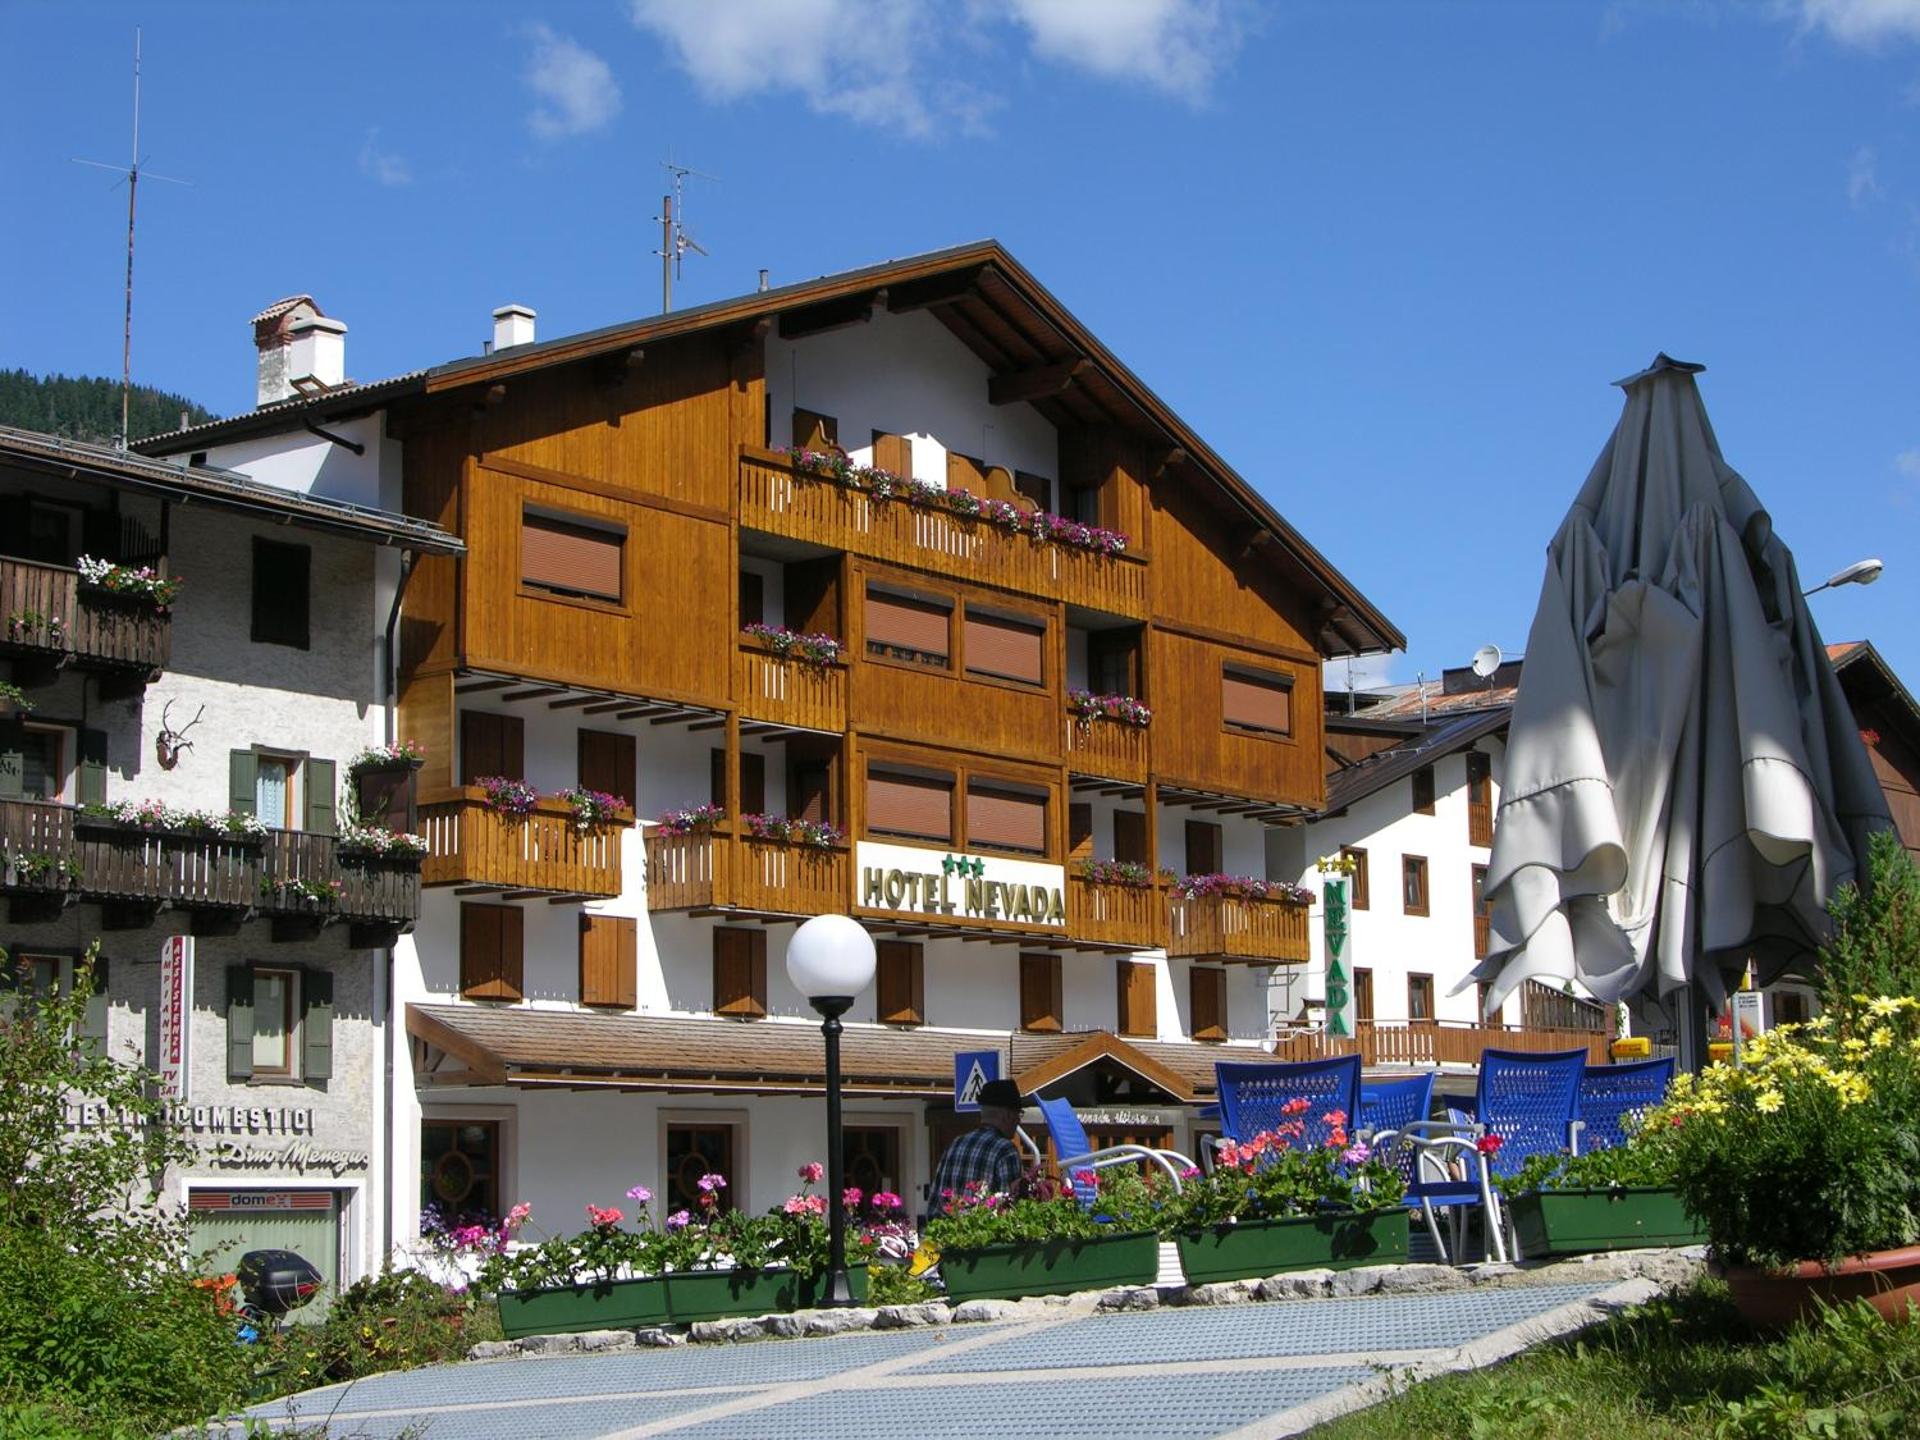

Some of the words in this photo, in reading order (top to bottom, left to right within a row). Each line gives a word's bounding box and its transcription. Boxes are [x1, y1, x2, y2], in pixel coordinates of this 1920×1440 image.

[864, 867, 956, 911] HOTEL
[965, 877, 1065, 920] NEVADA
[1325, 881, 1348, 1036] NEVADA
[163, 946, 171, 1057] IMPIANTI
[172, 944, 181, 1057] ASSISTENZA
[160, 1086, 177, 1096] SAT
[162, 1070, 177, 1081] TV
[220, 1140, 276, 1163] Dino
[279, 1141, 368, 1172] Menegus
